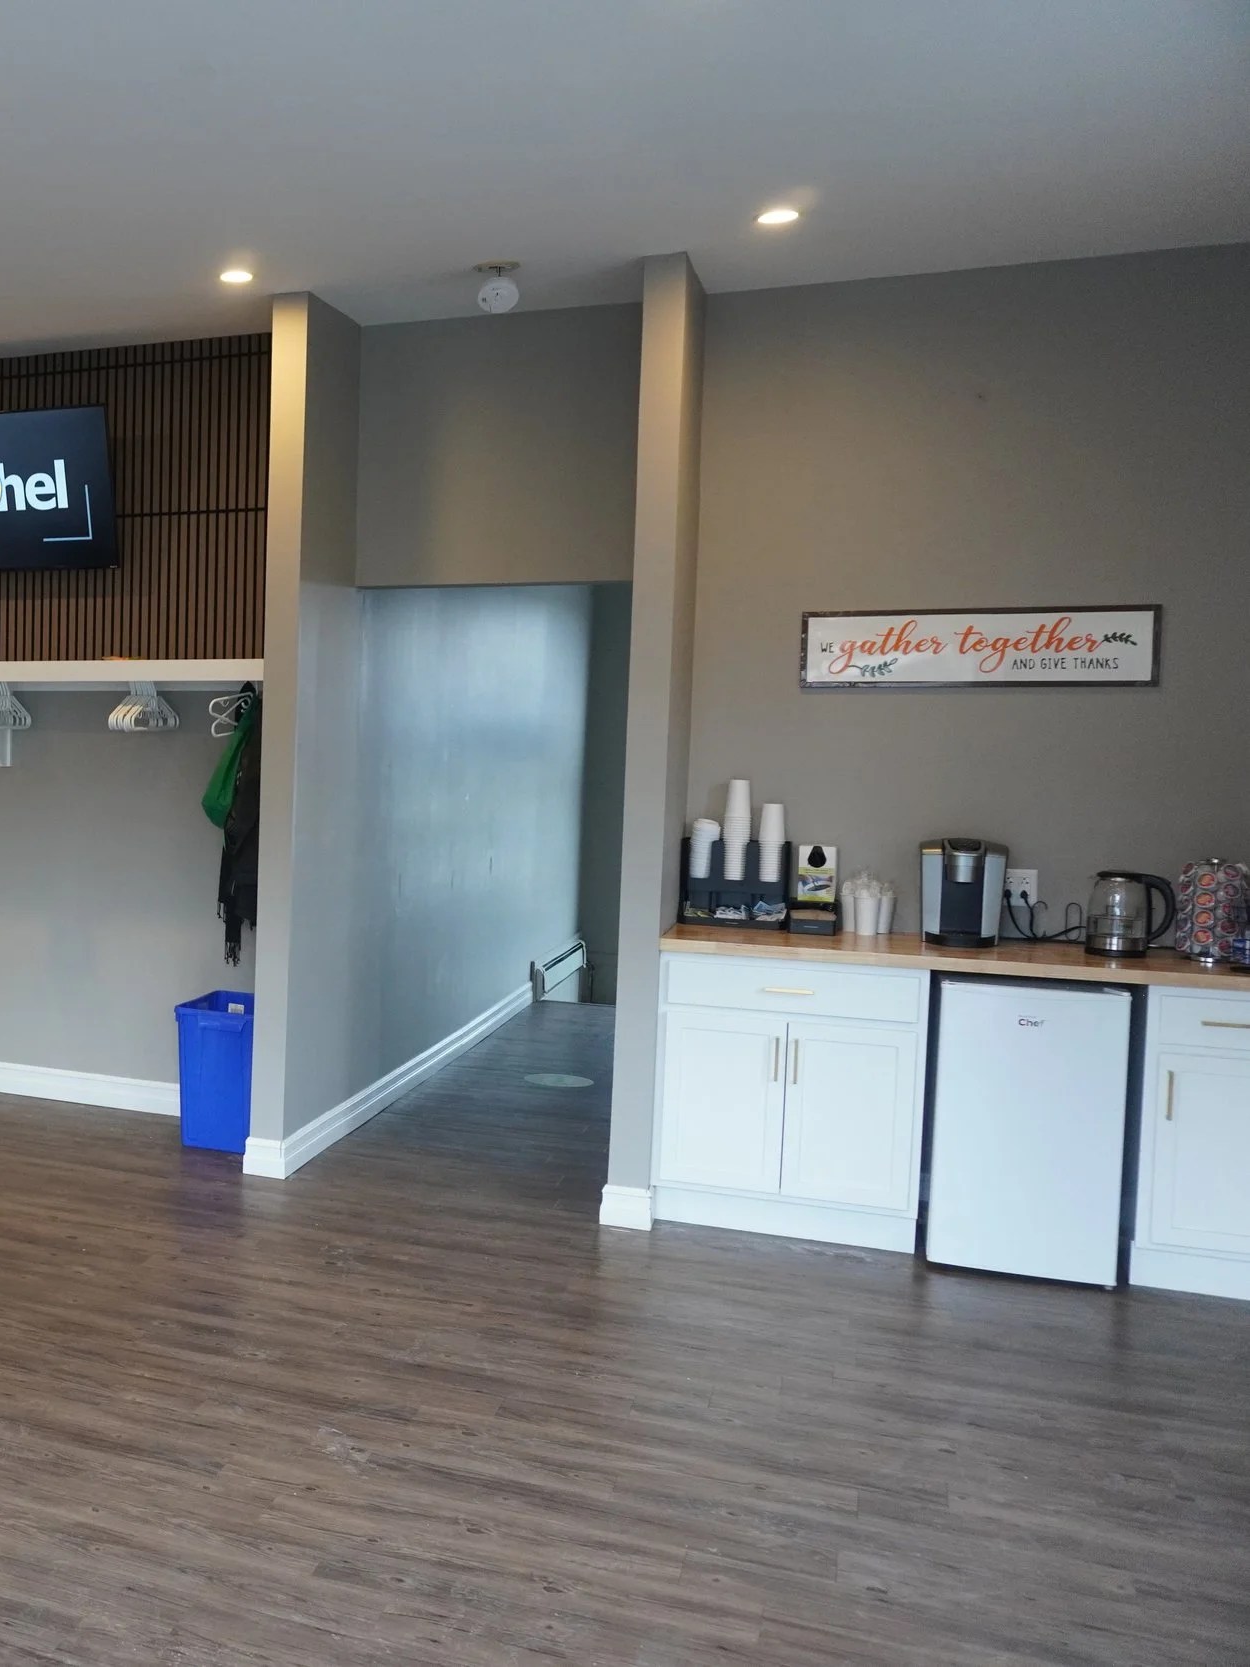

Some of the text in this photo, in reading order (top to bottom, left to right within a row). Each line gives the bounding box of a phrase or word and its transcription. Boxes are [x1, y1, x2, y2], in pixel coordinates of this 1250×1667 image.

[820, 617, 1102, 674] WE gather together
[1011, 657, 1119, 670] AND GIVE THANKS
